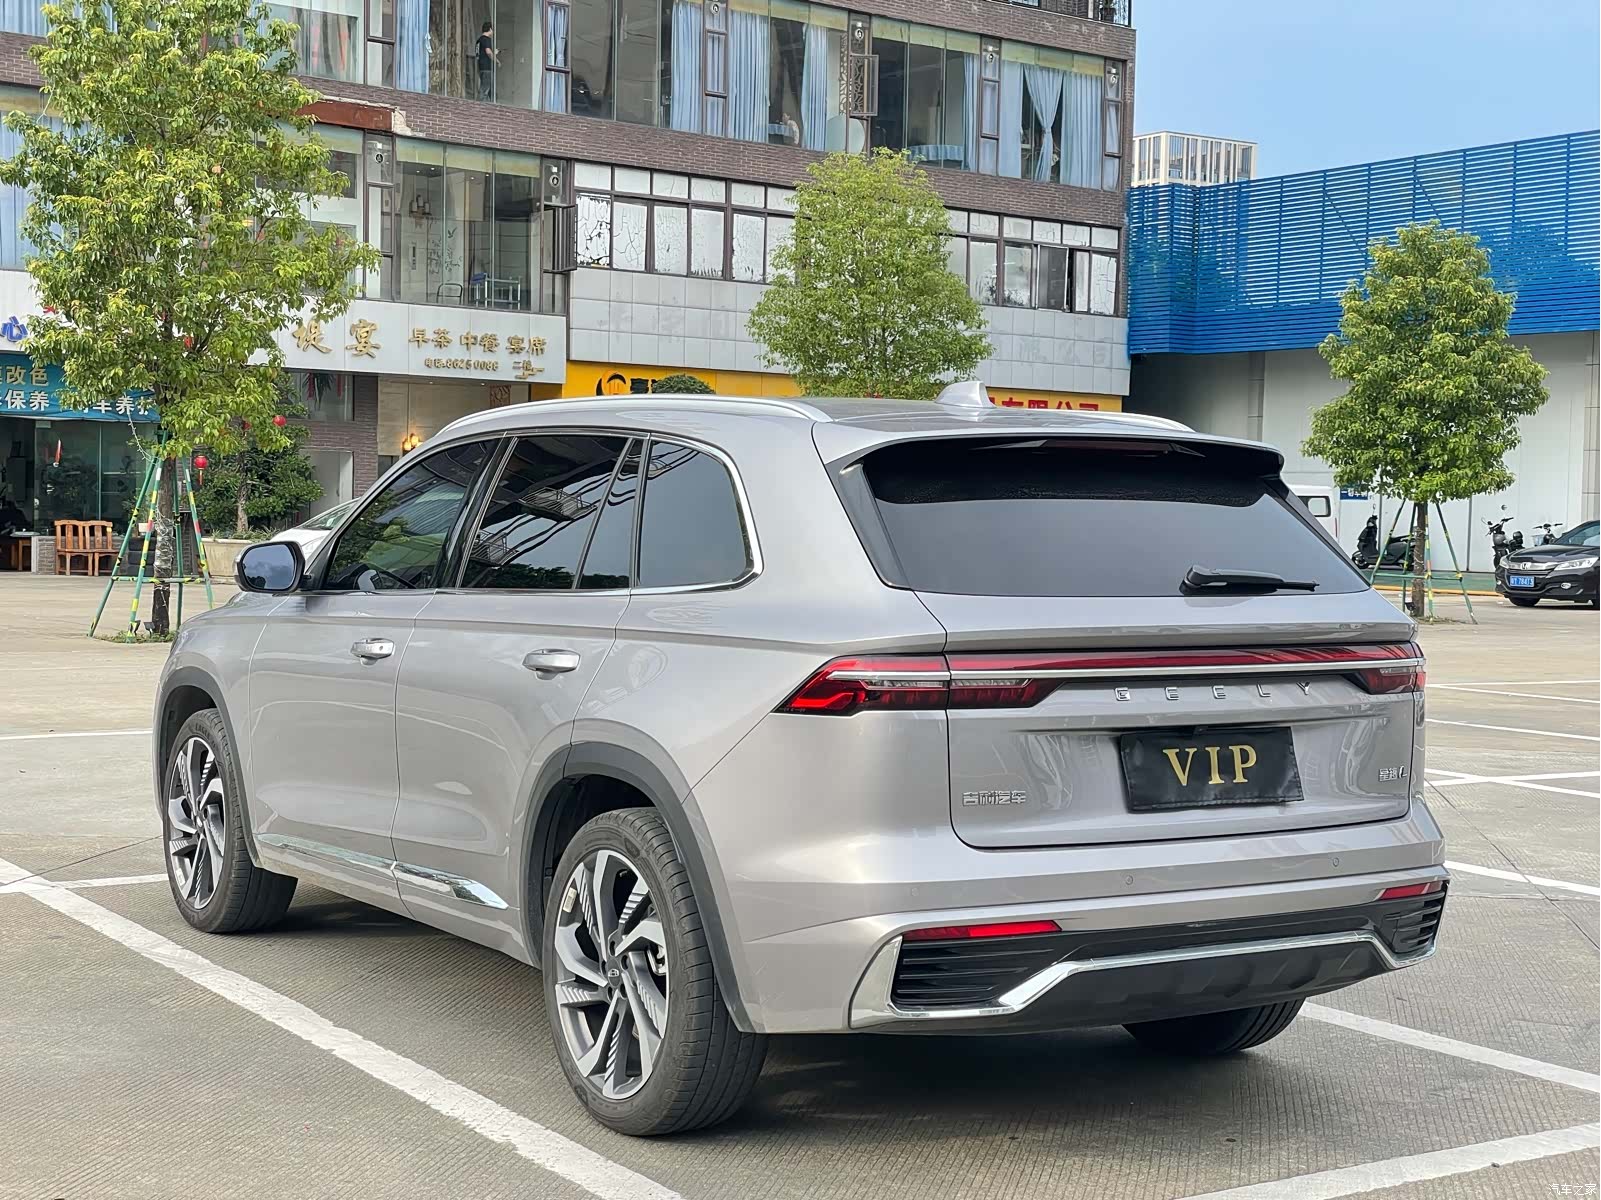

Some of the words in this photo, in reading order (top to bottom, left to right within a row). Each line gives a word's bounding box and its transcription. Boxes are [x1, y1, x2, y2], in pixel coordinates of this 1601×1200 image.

[0, 315, 28, 342] 心
[409, 327, 453, 349] 早茶
[460, 331, 500, 353] 中餐
[506, 334, 547, 356] 宴席
[0, 364, 49, 387] 改色
[0, 389, 50, 411] 保养
[1114, 681, 1311, 701] GEELY
[1162, 744, 1257, 786] VIP
[962, 789, 1027, 807] 吉利汽车
